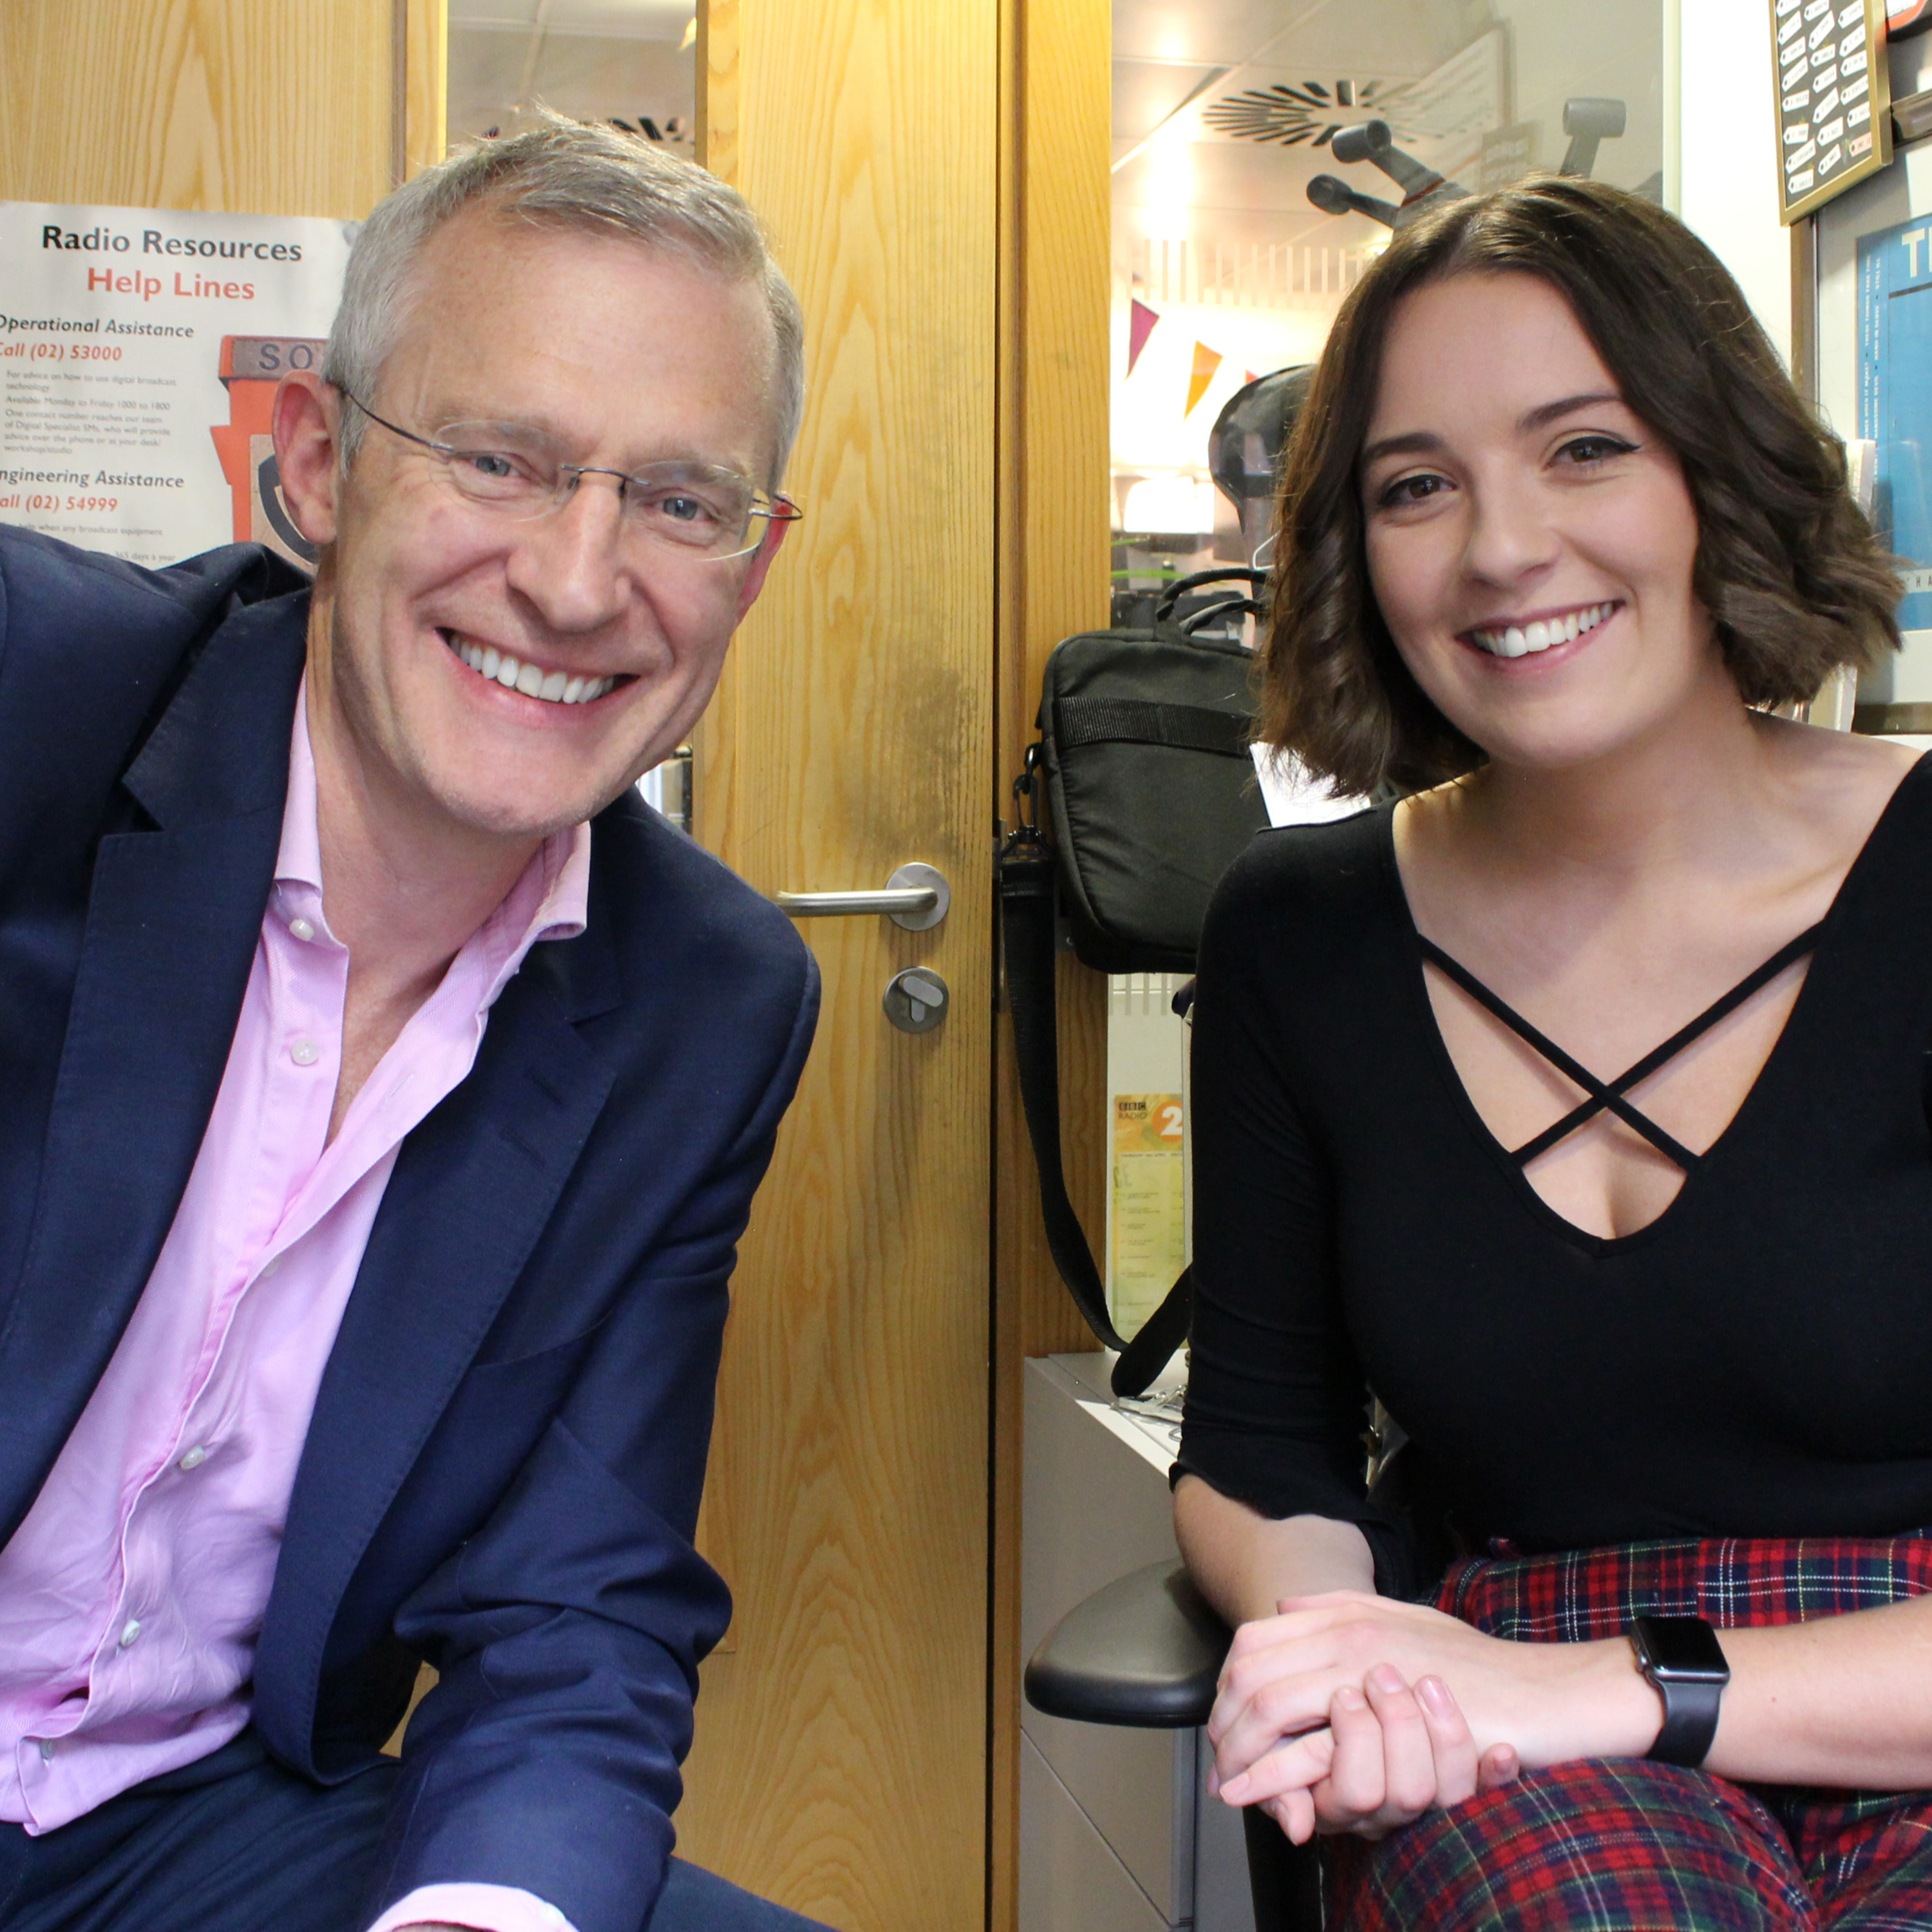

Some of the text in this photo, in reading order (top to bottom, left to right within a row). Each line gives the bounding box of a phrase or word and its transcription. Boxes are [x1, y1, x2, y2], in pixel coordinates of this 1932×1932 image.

[43, 225, 302, 261] Radio Resources
[88, 267, 255, 301] Help Lines
[0, 314, 194, 337] Operational Assistance
[30, 343, 64, 363] (02)
[70, 345, 122, 361] 53000
[0, 467, 185, 488] ngineering Assistance
[0, 494, 118, 514] all (02) 54999
[1160, 1106, 1183, 1135] 2
